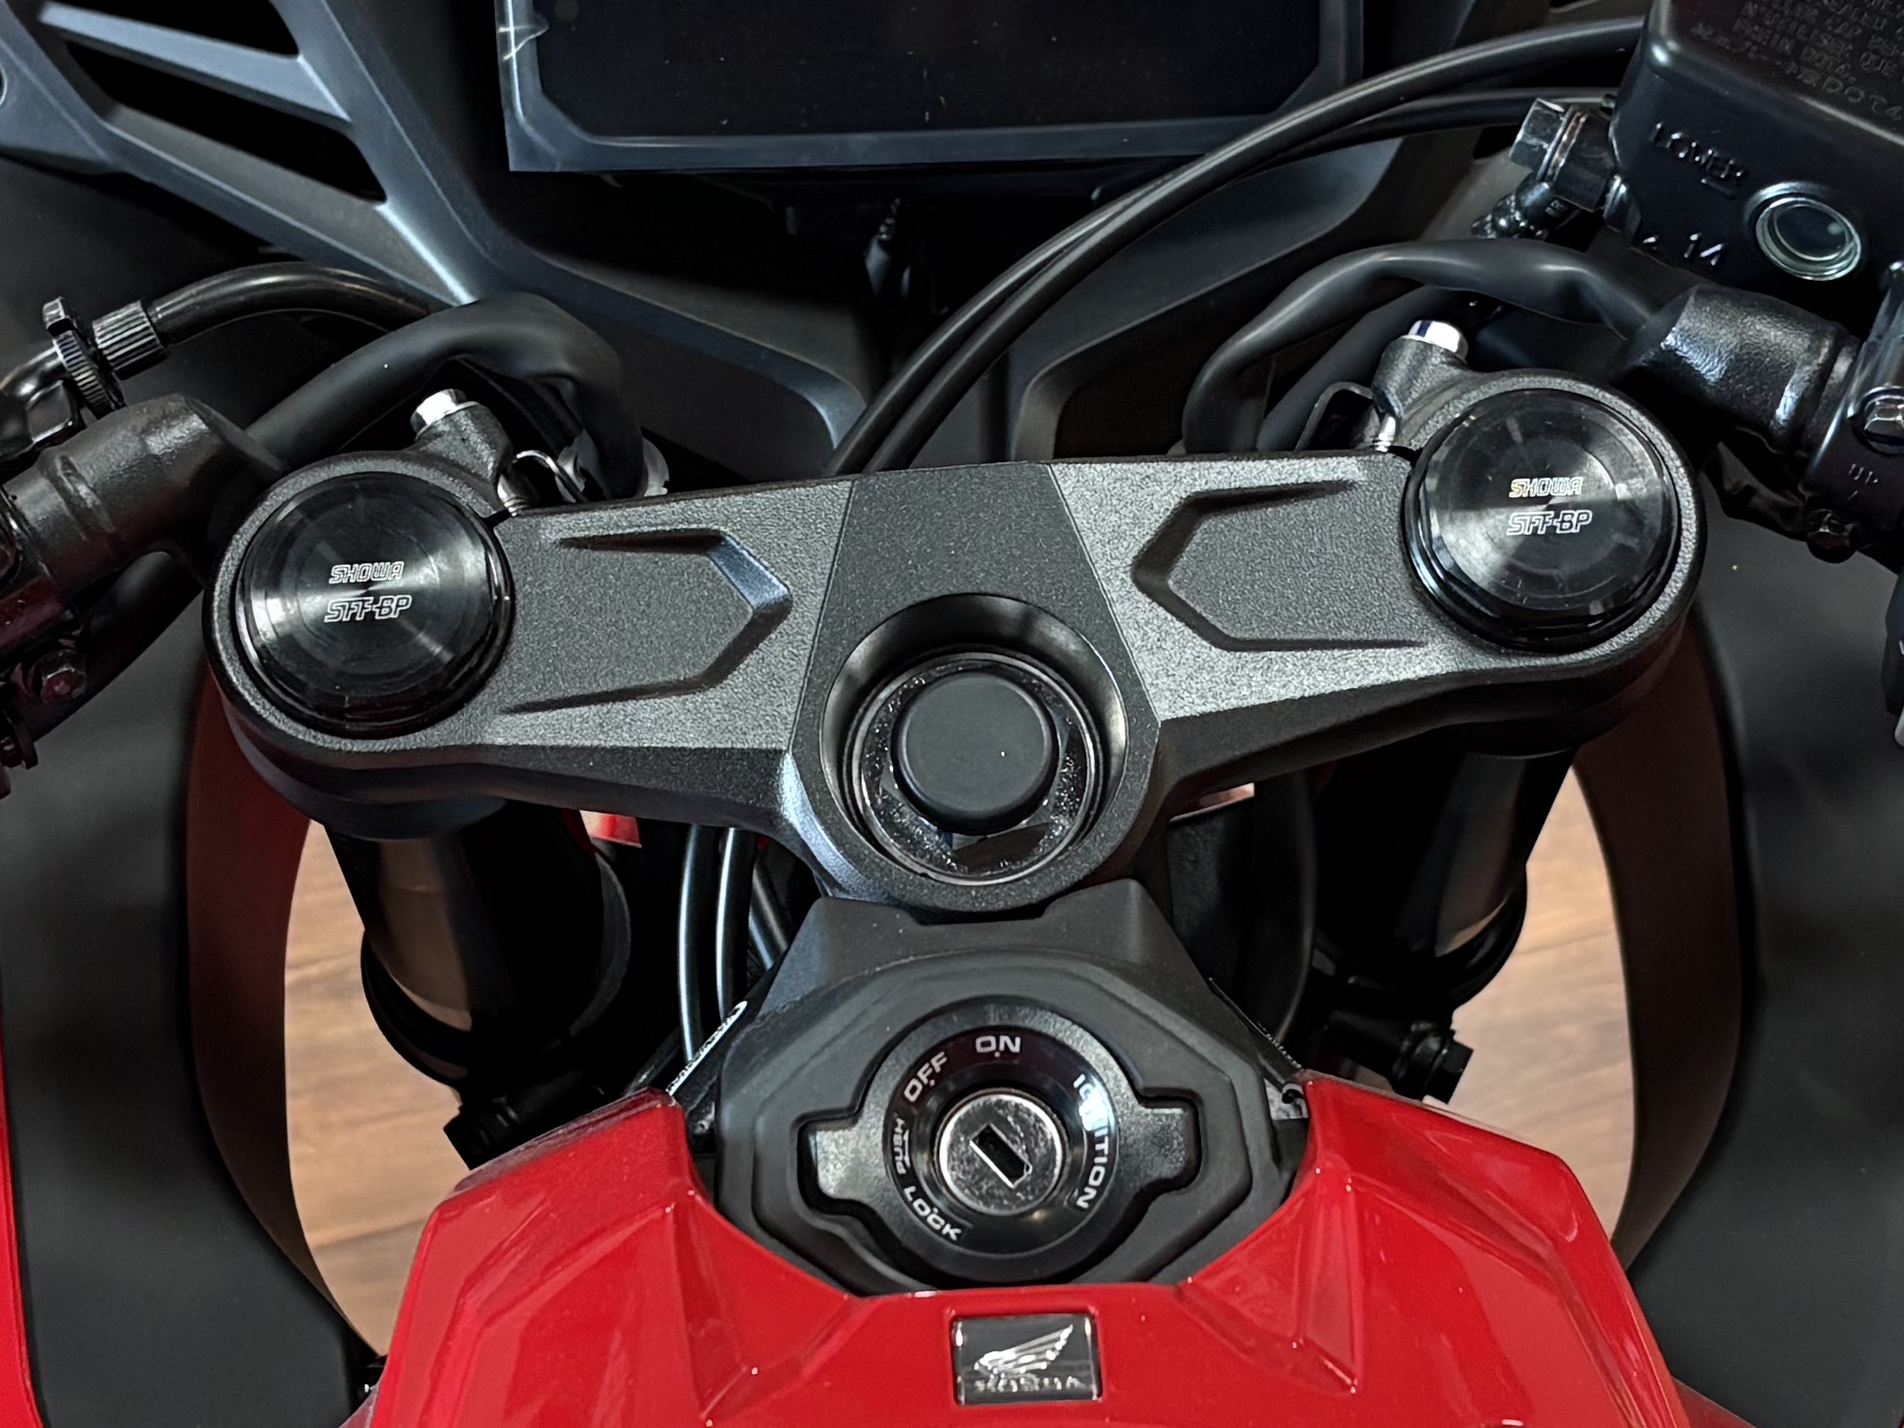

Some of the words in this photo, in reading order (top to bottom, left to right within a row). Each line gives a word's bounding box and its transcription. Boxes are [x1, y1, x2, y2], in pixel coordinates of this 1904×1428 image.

[1508, 476, 1585, 498] SHOWA
[1506, 509, 1593, 536] SFF-BP
[329, 561, 404, 584] SHOWA
[323, 595, 412, 623] SFF-BP
[975, 1035, 1022, 1054] ON
[904, 1051, 948, 1103] OFF
[892, 1117, 907, 1175] PUSH
[904, 1185, 962, 1242] LOCK
